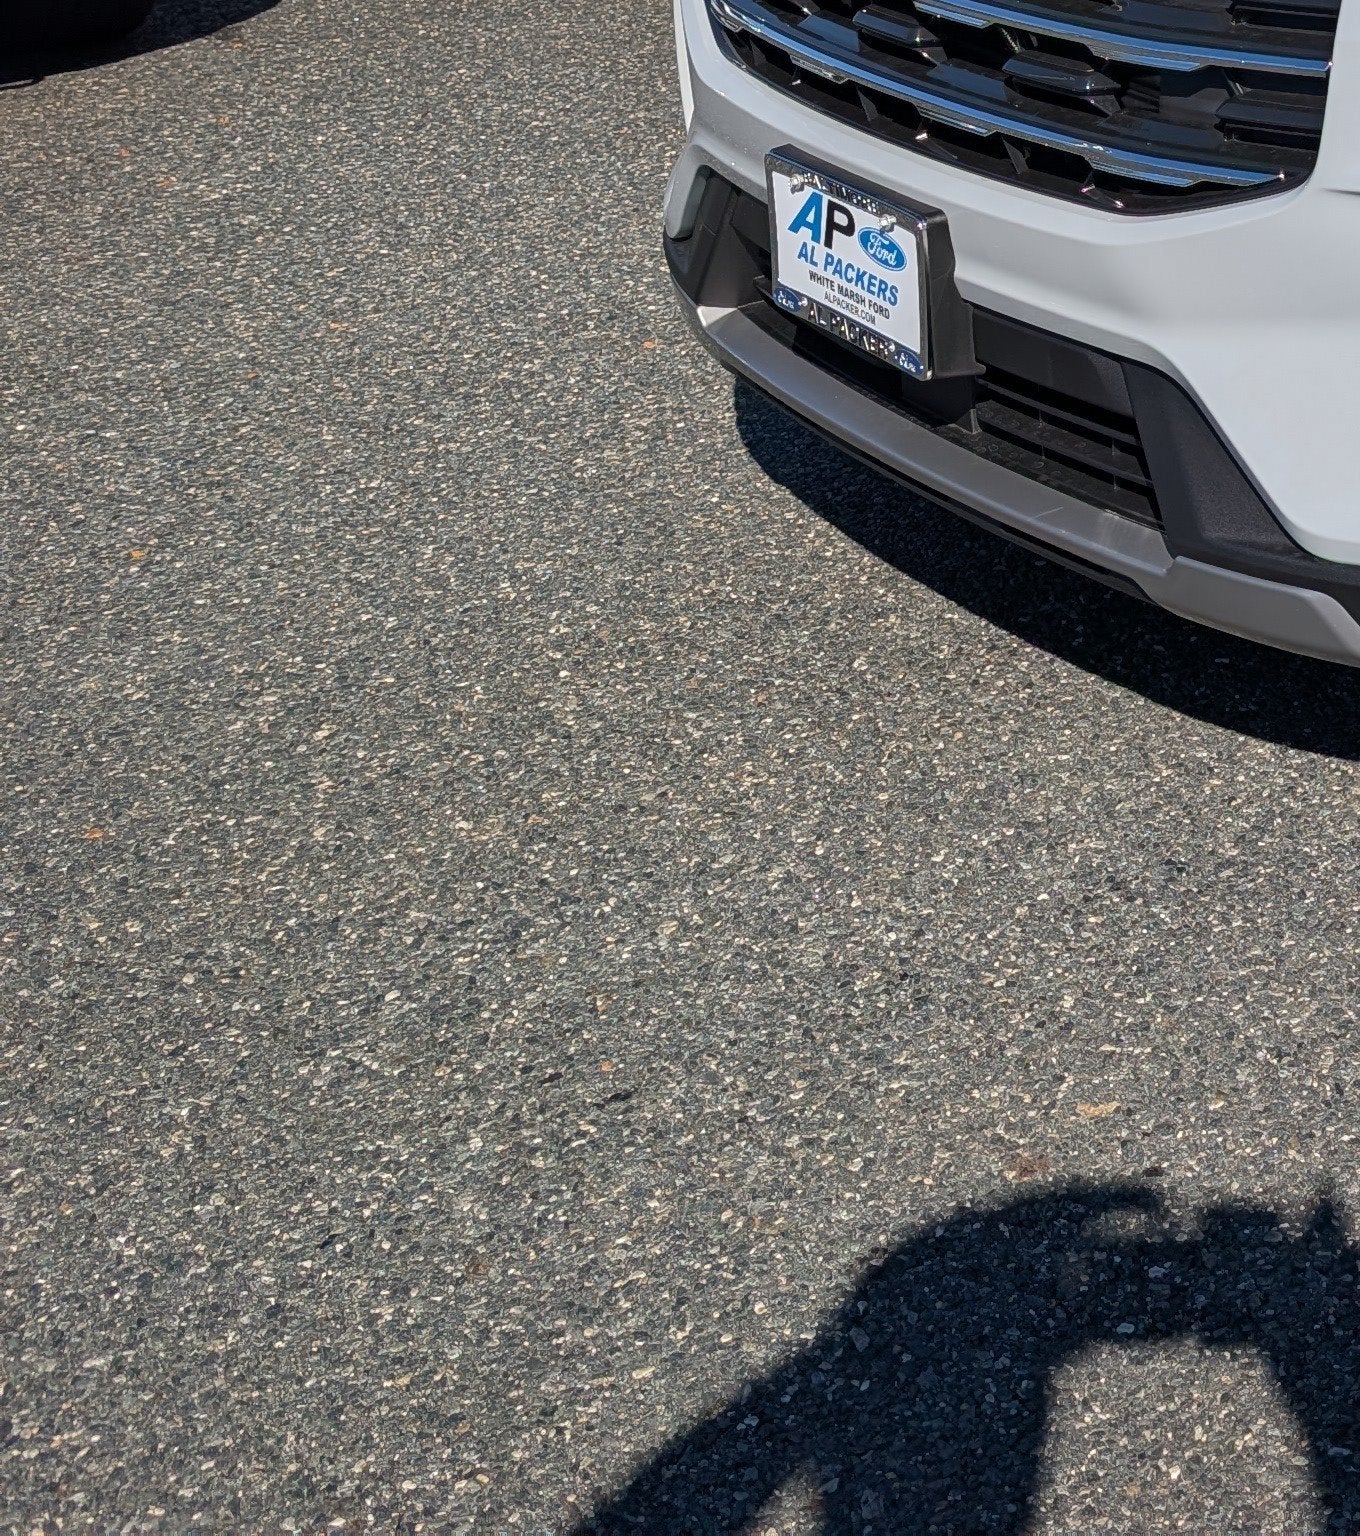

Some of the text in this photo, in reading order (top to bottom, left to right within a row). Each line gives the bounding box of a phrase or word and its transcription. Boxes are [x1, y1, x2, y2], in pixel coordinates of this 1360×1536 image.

[788, 191, 855, 249] AP
[797, 242, 898, 306] AL PACKERS
[867, 231, 898, 266] Ford
[809, 269, 890, 319] WHITE MARSH FORD
